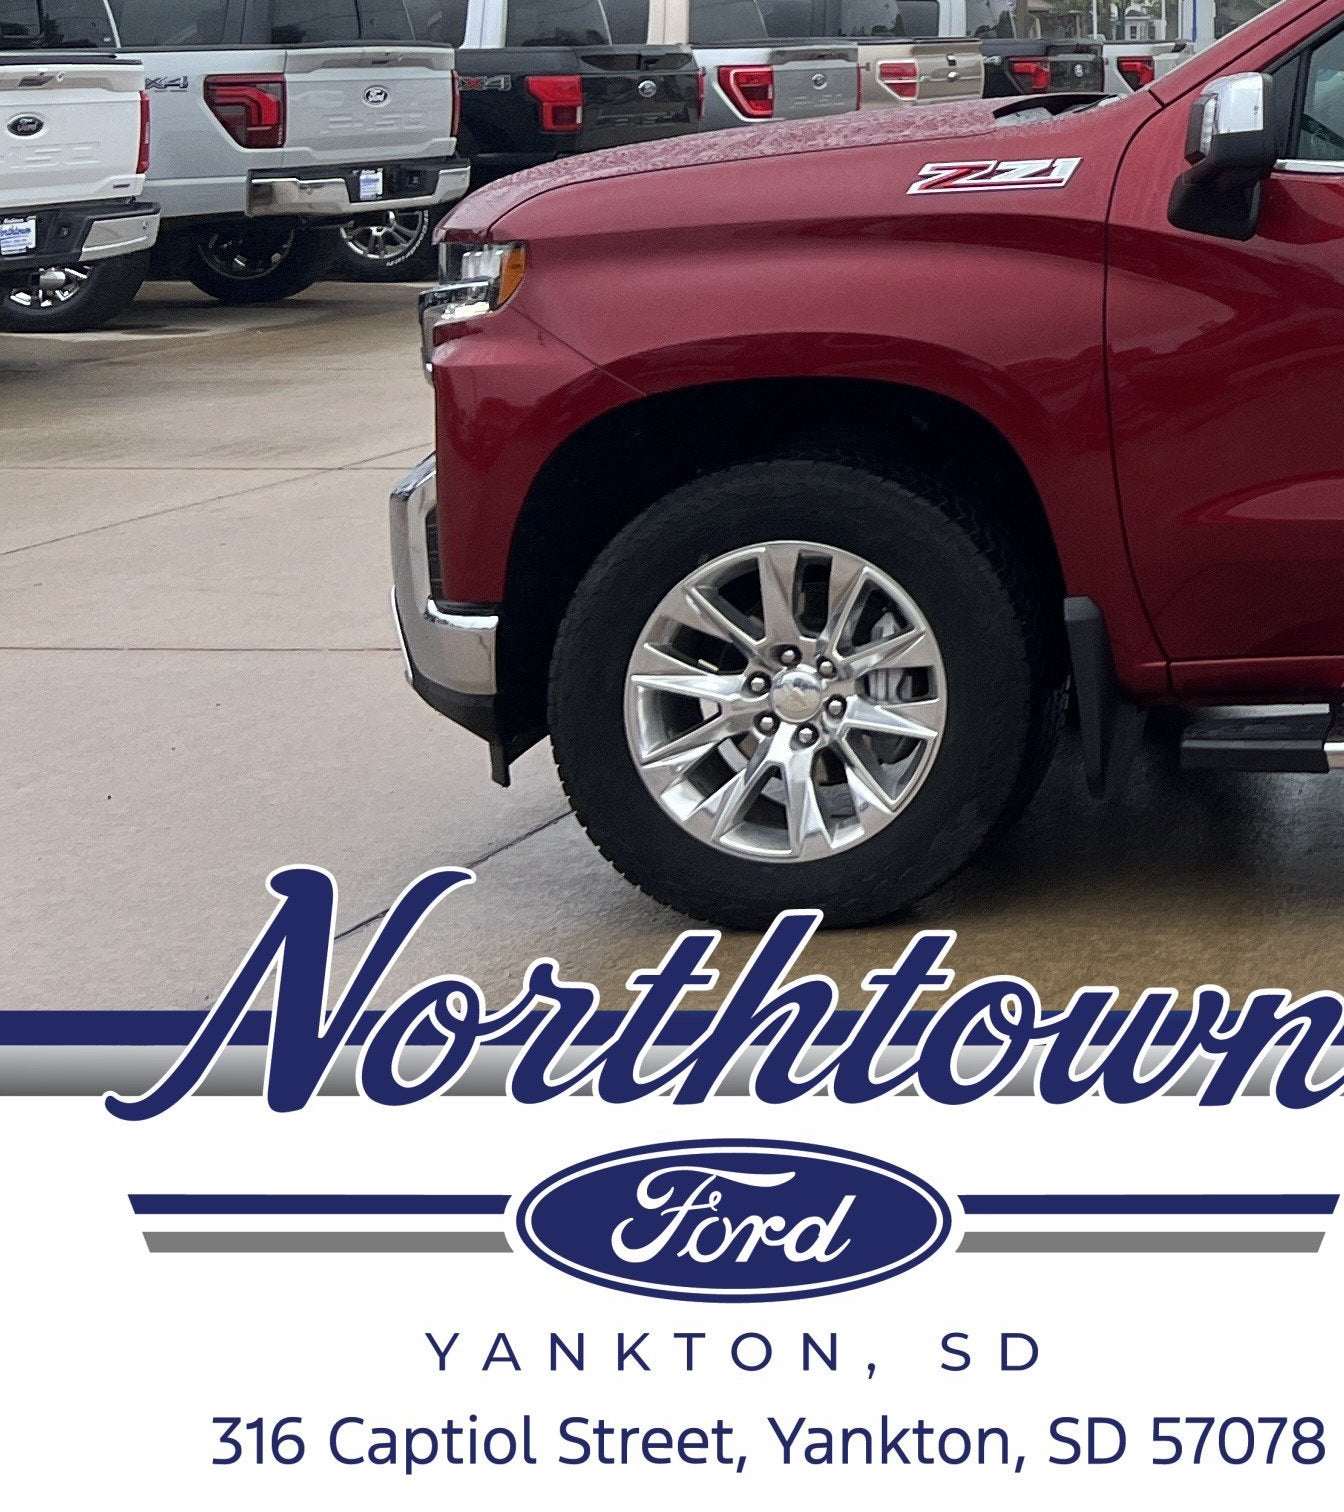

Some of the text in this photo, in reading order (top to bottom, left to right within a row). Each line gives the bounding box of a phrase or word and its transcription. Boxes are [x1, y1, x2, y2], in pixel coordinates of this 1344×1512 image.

[145, 76, 189, 89] X4
[459, 75, 512, 91] X4
[906, 157, 1083, 195] Z71
